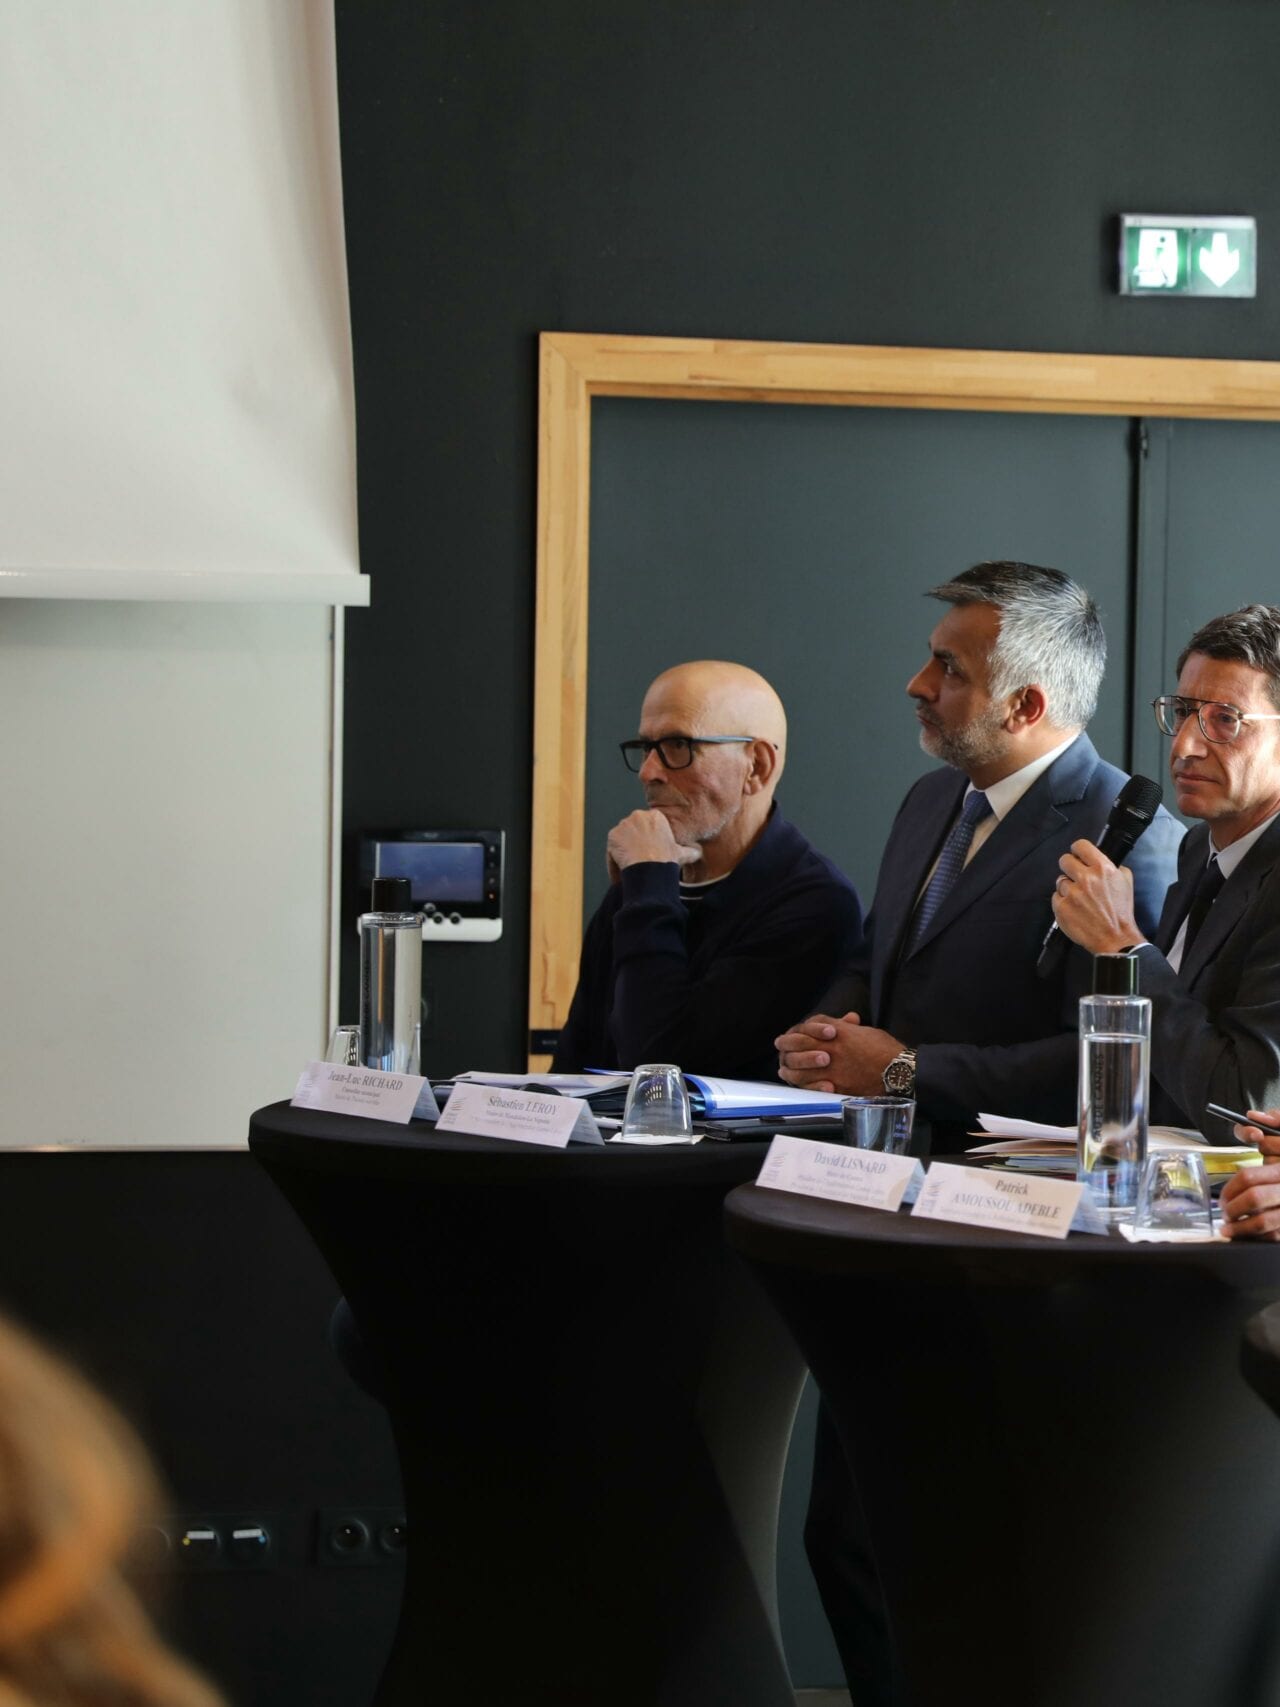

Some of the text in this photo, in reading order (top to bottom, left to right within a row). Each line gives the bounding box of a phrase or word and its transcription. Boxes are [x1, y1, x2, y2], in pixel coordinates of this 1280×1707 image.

[328, 1070, 403, 1090] Jean-Luc RICHARD
[487, 1096, 559, 1115] Sébastien LEROY
[814, 1152, 887, 1174] David LISNARD
[995, 1180, 1029, 1195] Patrick
